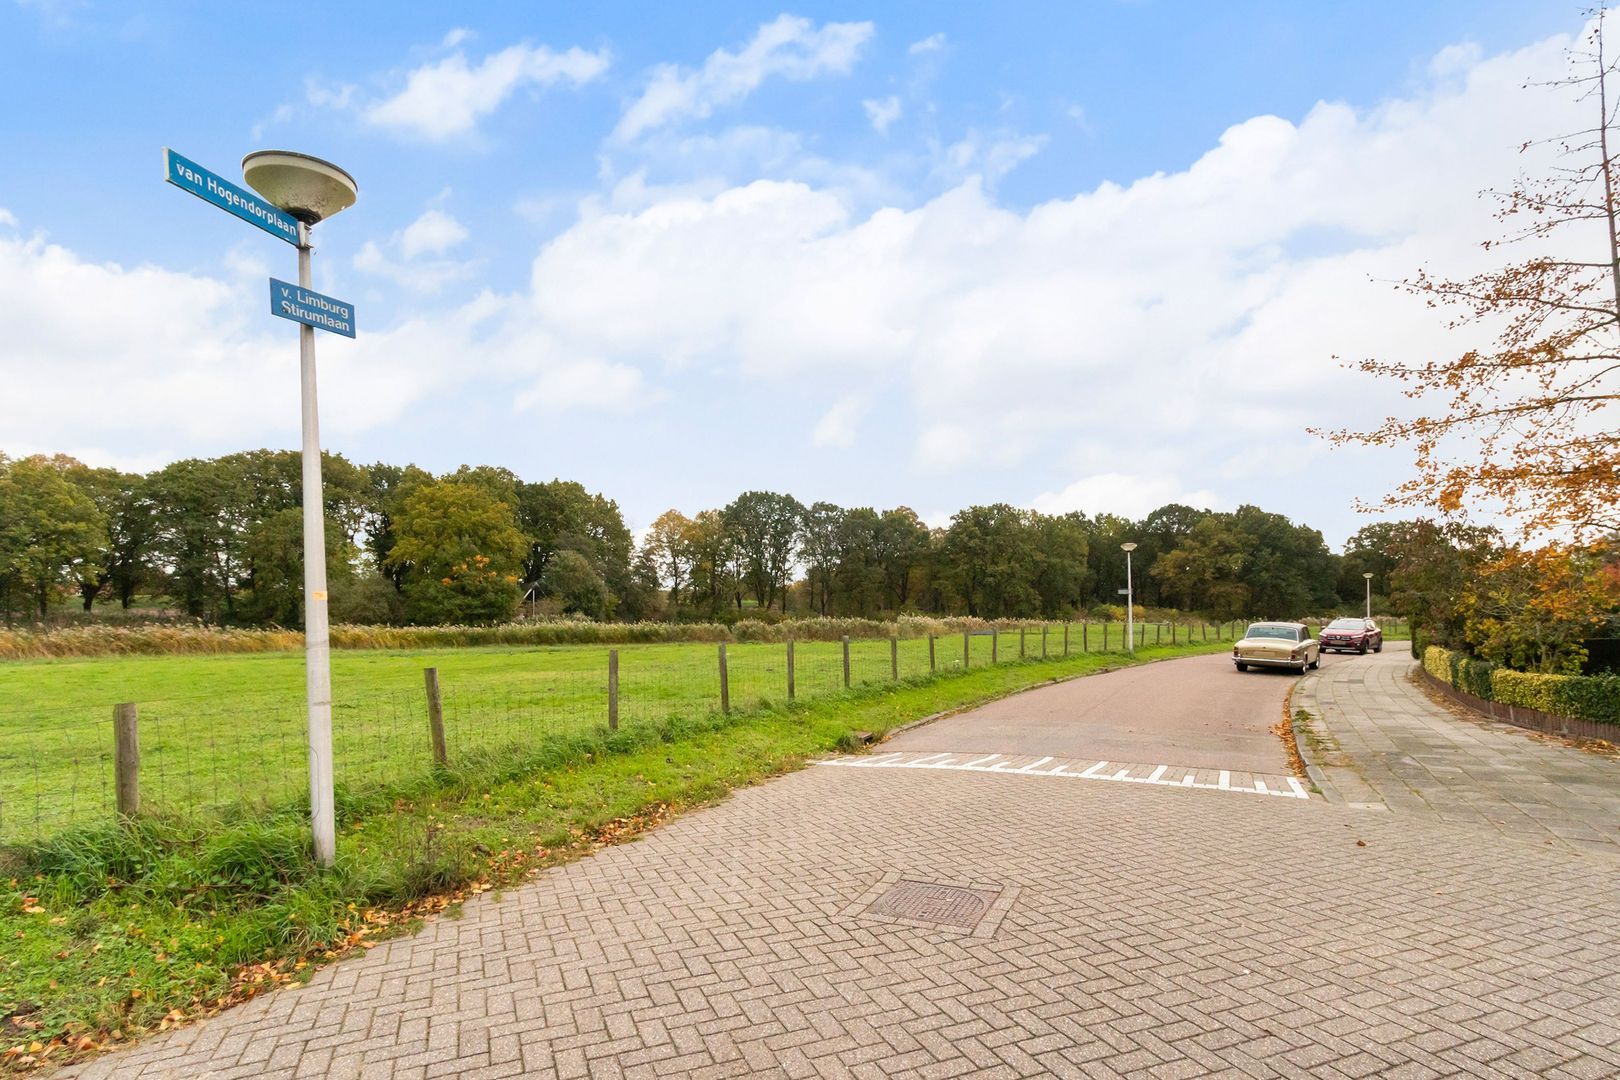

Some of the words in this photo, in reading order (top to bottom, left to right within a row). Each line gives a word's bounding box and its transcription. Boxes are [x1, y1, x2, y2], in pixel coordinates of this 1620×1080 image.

[176, 163, 202, 186] van
[207, 178, 297, 236] Hogendorplaan
[281, 287, 292, 299] v.
[297, 290, 349, 319] Limburg
[281, 301, 350, 332] Stirumlaan
